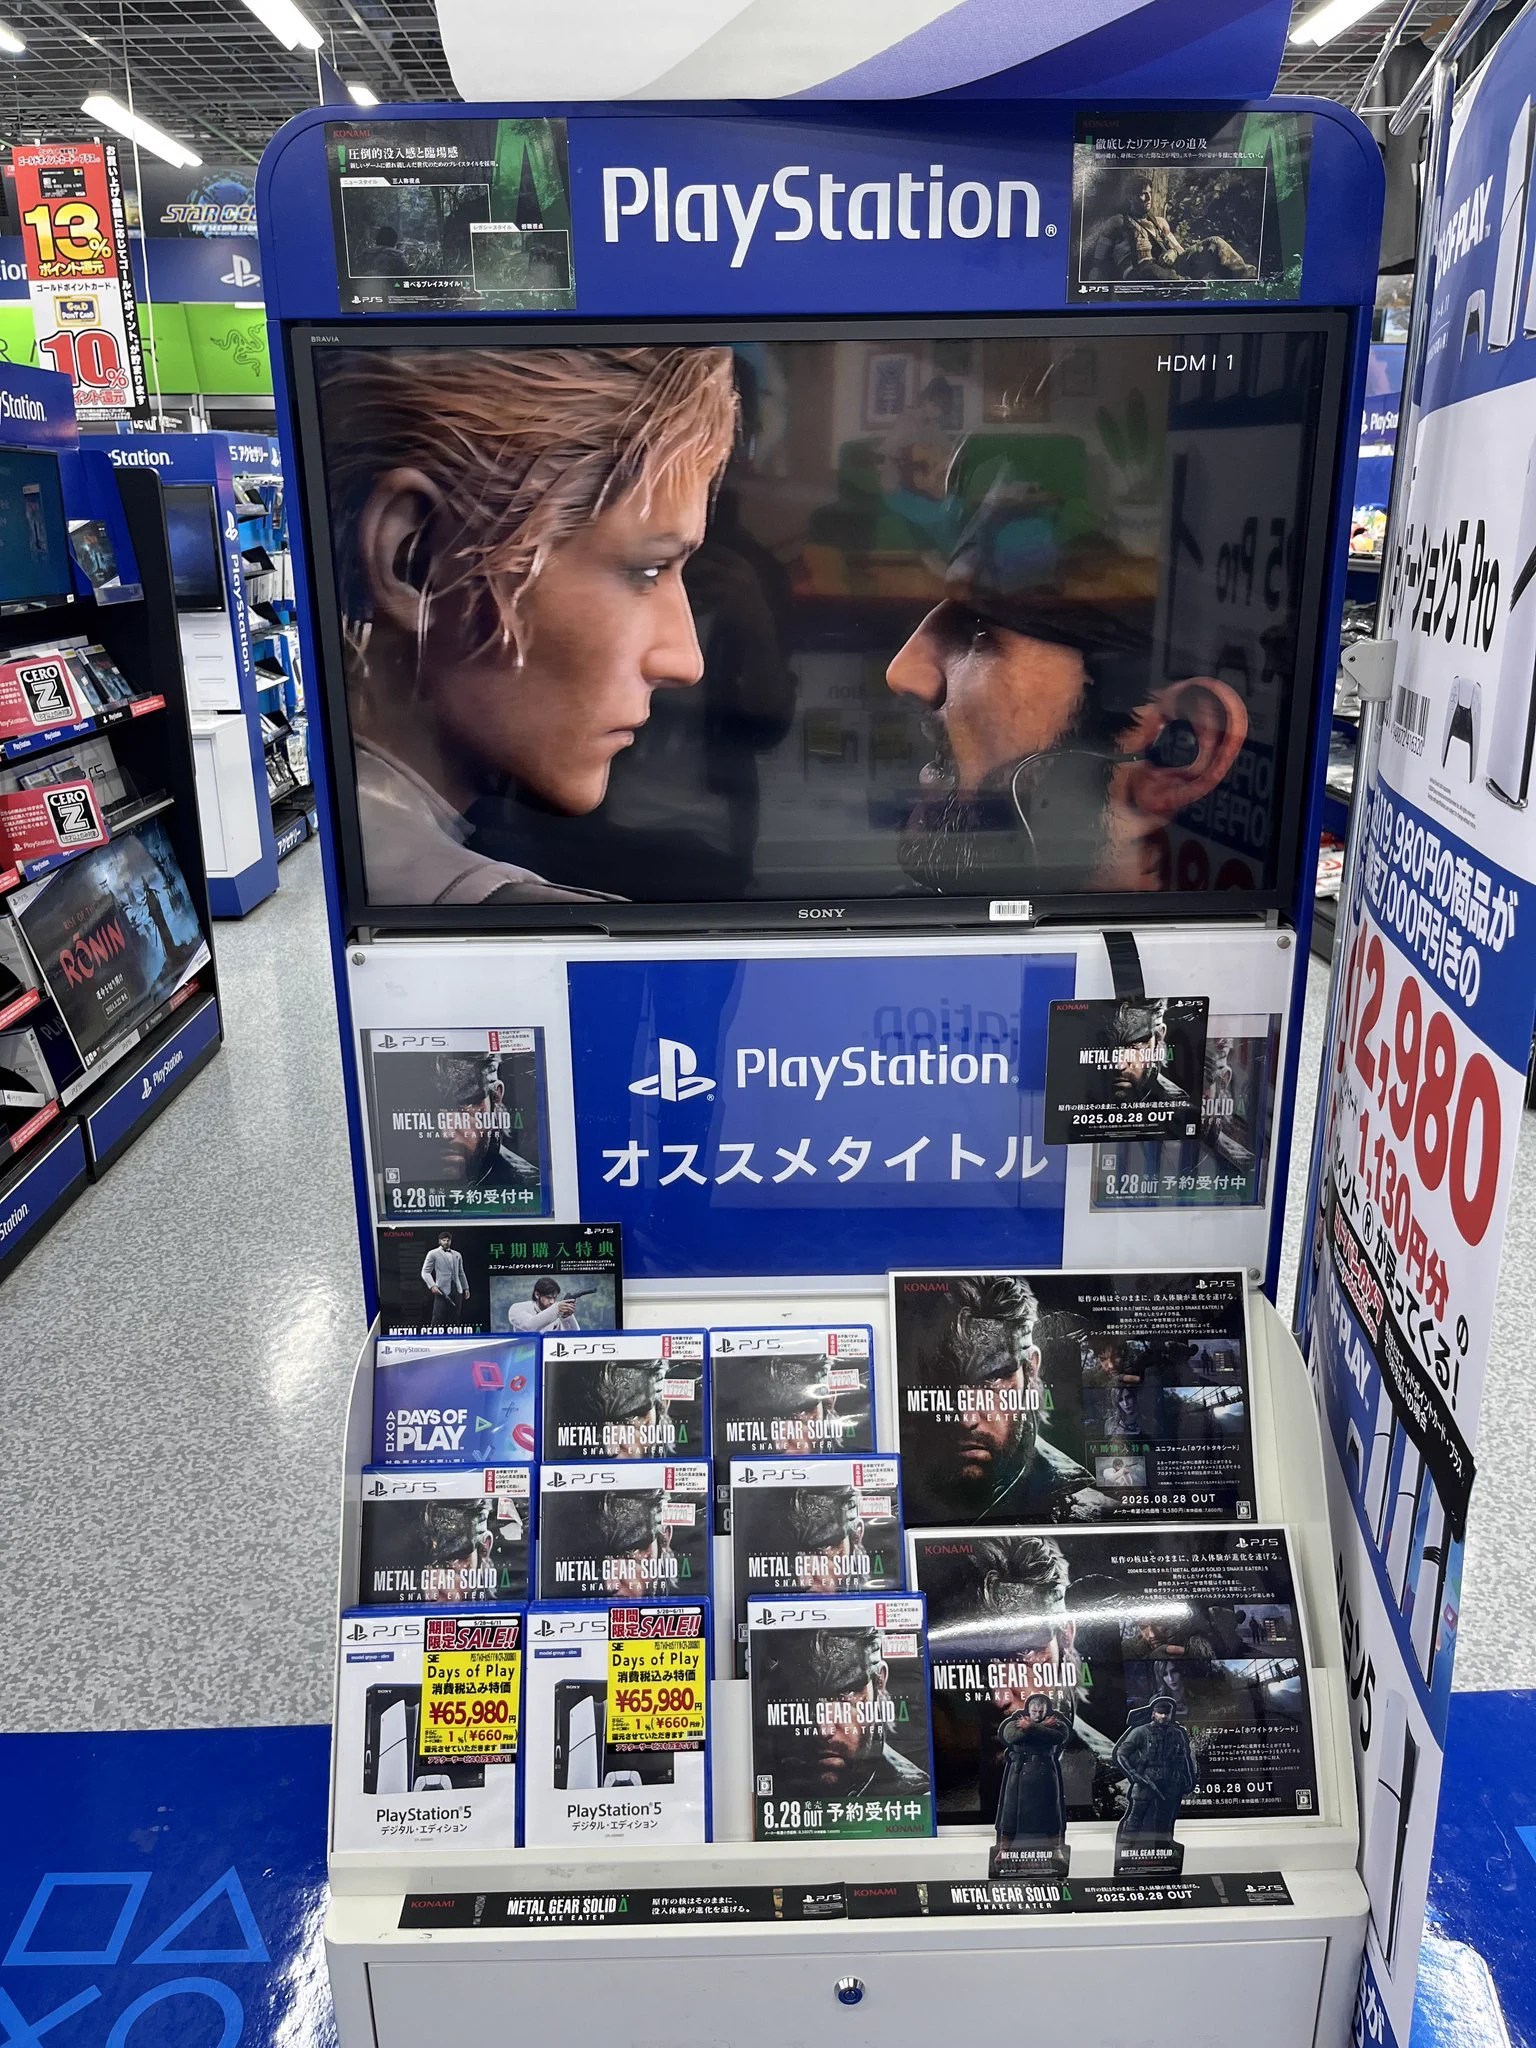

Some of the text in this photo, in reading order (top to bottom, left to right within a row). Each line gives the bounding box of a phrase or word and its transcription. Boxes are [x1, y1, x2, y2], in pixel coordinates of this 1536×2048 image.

[333, 130, 371, 138] KONAMI
[1088, 285, 1110, 293] PS5
[0, 390, 46, 423] Station
[1463, 519, 1500, 653] Pro
[231, 554, 251, 675] PlayStation
[22, 666, 58, 683] CERO
[31, 679, 64, 711] Z
[49, 790, 86, 807] CERO
[58, 802, 91, 833] Z
[797, 908, 845, 920] SONY
[1056, 1003, 1089, 1011] KONAMI
[402, 1036, 447, 1047] PS5
[1079, 1048, 1165, 1064] METAL GEAR SOLID
[152, 1048, 184, 1089] PlayStation
[392, 1111, 511, 1131] METAL GEAR SOLID
[1072, 1111, 1175, 1124] 2025.08.28 OUT
[602, 1133, 1049, 1188] オススメタイトル
[1105, 1174, 1247, 1195] 8.28 予約受付中
[392, 1188, 535, 1209] 8.28 OUT 予約受付中
[489, 1241, 615, 1259] 早期購入特典
[903, 1283, 949, 1293] KONAMI
[1209, 1280, 1236, 1288] PS5
[394, 1346, 430, 1355] PlayStation
[573, 1343, 616, 1355] PS5
[738, 1339, 781, 1350] PS5
[907, 1388, 1040, 1412] METAL GEAR SOLID
[397, 1409, 468, 1426] DAYS OF
[558, 1424, 676, 1447] METAL GEAR SOLID
[726, 1419, 843, 1442] METAL GEAR SOLID
[396, 1425, 468, 1452] PLAY
[571, 1472, 616, 1484] PS5
[762, 1469, 807, 1481] PS5
[392, 1482, 437, 1494] PS5
[1121, 1493, 1216, 1504] 2025.08.28 OUT
[924, 1543, 974, 1555] KONAMI
[1250, 1538, 1279, 1547] PS5
[555, 1558, 678, 1582] METAL GEAR SOLID
[748, 1554, 871, 1578] METAL GEAR SOLID
[373, 1567, 498, 1592] METAL GEAR SOLID
[780, 1609, 827, 1622] PS5
[372, 1624, 420, 1638] PS5
[559, 1621, 606, 1634] PS5
[639, 1614, 702, 1638] SALE!!
[456, 1626, 520, 1649] SALE!!
[612, 1651, 700, 1670] Days of Play
[427, 1663, 516, 1682] Days of Play
[617, 1669, 696, 1683] 消費税込み特価
[933, 1661, 1077, 1690] METAL GEAR SOLID
[432, 1681, 512, 1695] 消費税込み特価
[965, 1691, 1011, 1702] SNAKE
[767, 1700, 896, 1726] METAL GEAR SOLID
[611, 1731, 685, 1741] 還元させていただきます
[424, 1744, 498, 1753] 還元させていただきます
[1246, 1781, 1273, 1793] OUT
[463, 1805, 472, 1819] 5
[653, 1801, 662, 1815] 5
[763, 1800, 922, 1829] 8.28 発売 OUT 予約受付中
[381, 1824, 468, 1835] デジタル・エディション
[571, 1819, 658, 1831] デジタル・エディション
[885, 1824, 925, 1834] KONAMI
[1001, 1850, 1053, 1860] METAL GEAR SOLID
[1121, 1849, 1173, 1858] METAL GEAR SOLID
[853, 1887, 898, 1897] KONAMI
[951, 1886, 1061, 1903] METAL GEAR SOLID
[1257, 1884, 1284, 1892] PS5
[652, 1897, 738, 1906] 原作の核はそのままに、
[816, 1893, 842, 1901] PS5
[1095, 1890, 1193, 1903] 2025.08.28 OUT
[411, 1900, 455, 1909] KONAMI
[507, 1897, 617, 1917] METAL GEAR SOLID
[651, 1905, 751, 1915] 没入体験が進化を遂げる。
